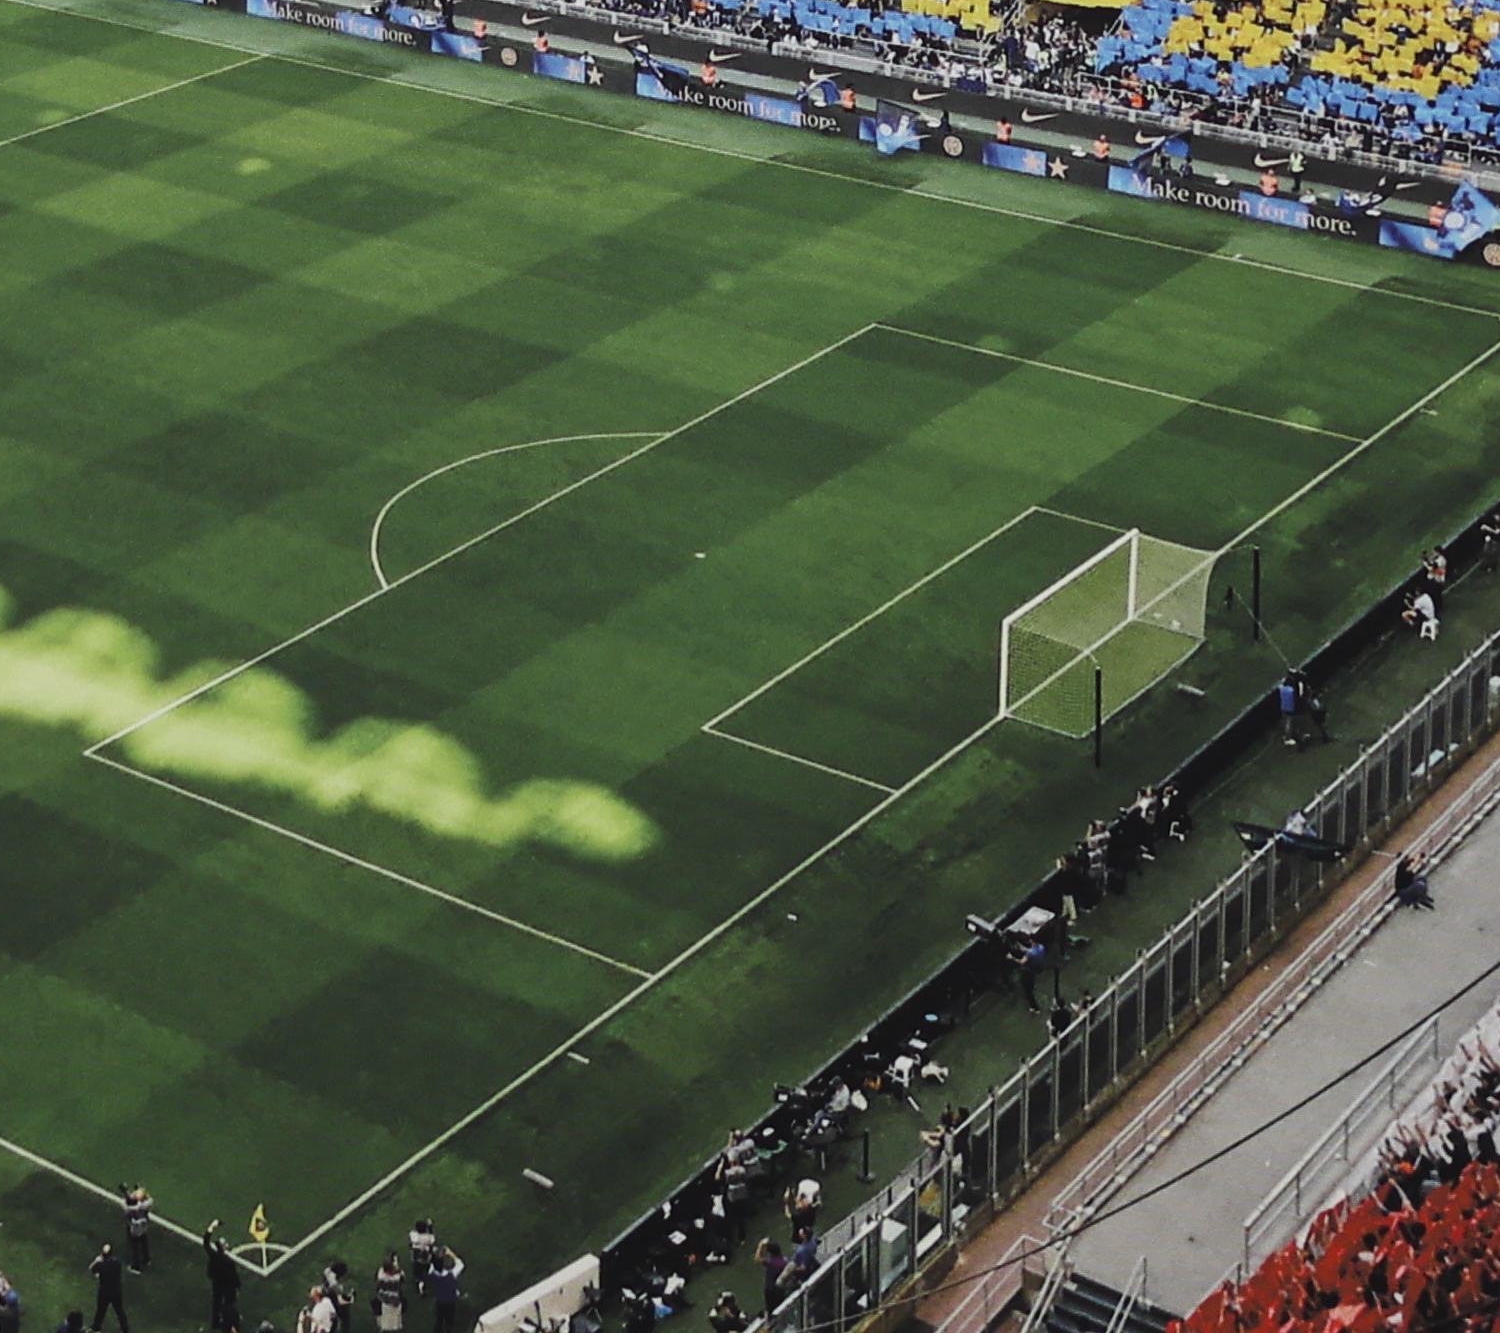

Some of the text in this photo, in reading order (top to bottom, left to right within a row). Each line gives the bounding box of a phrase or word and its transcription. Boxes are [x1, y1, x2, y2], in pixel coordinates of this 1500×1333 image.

[265, 0, 303, 25] Make
[306, 12, 345, 31] room
[378, 24, 417, 47] more.
[708, 93, 754, 116] room
[1132, 174, 1357, 236] Make room for more.
